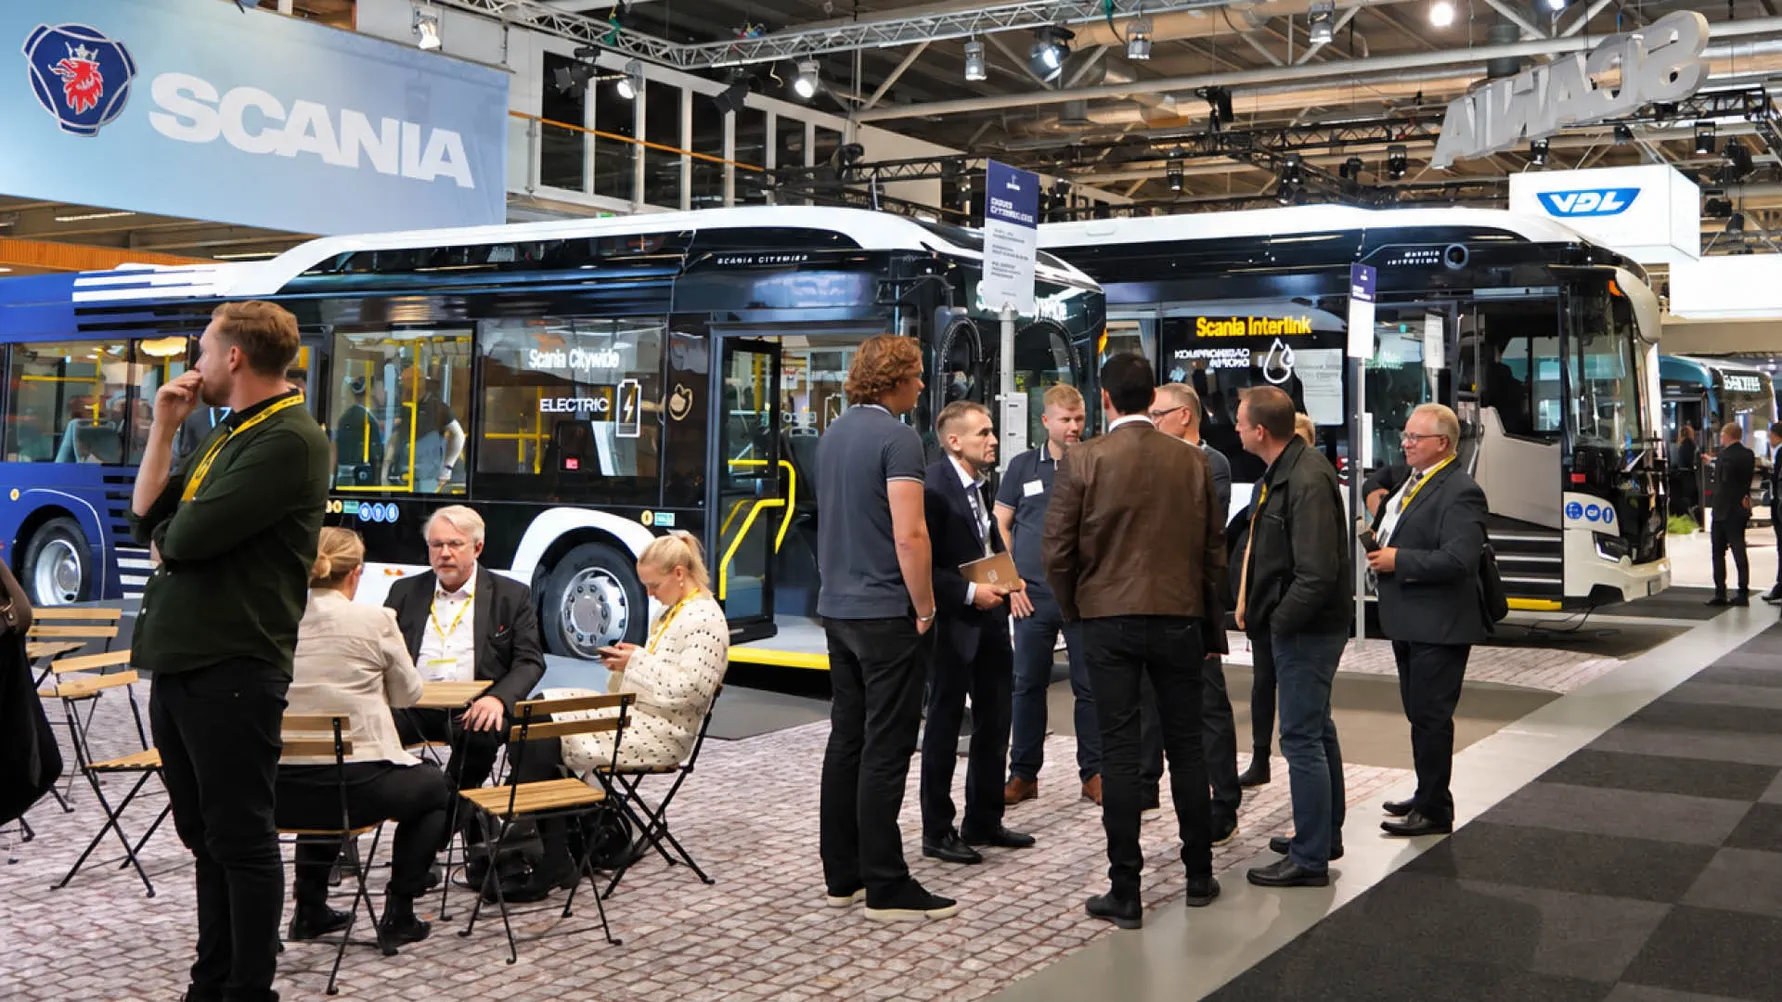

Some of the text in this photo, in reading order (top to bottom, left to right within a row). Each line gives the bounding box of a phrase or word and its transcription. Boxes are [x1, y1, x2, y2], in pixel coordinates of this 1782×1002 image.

[148, 72, 475, 189] SCANIA
[1550, 191, 1625, 214] VDL
[1196, 315, 1312, 337] Scania Interlink
[529, 347, 620, 373] Scania Citywide
[540, 397, 609, 413] ELECTRIC
